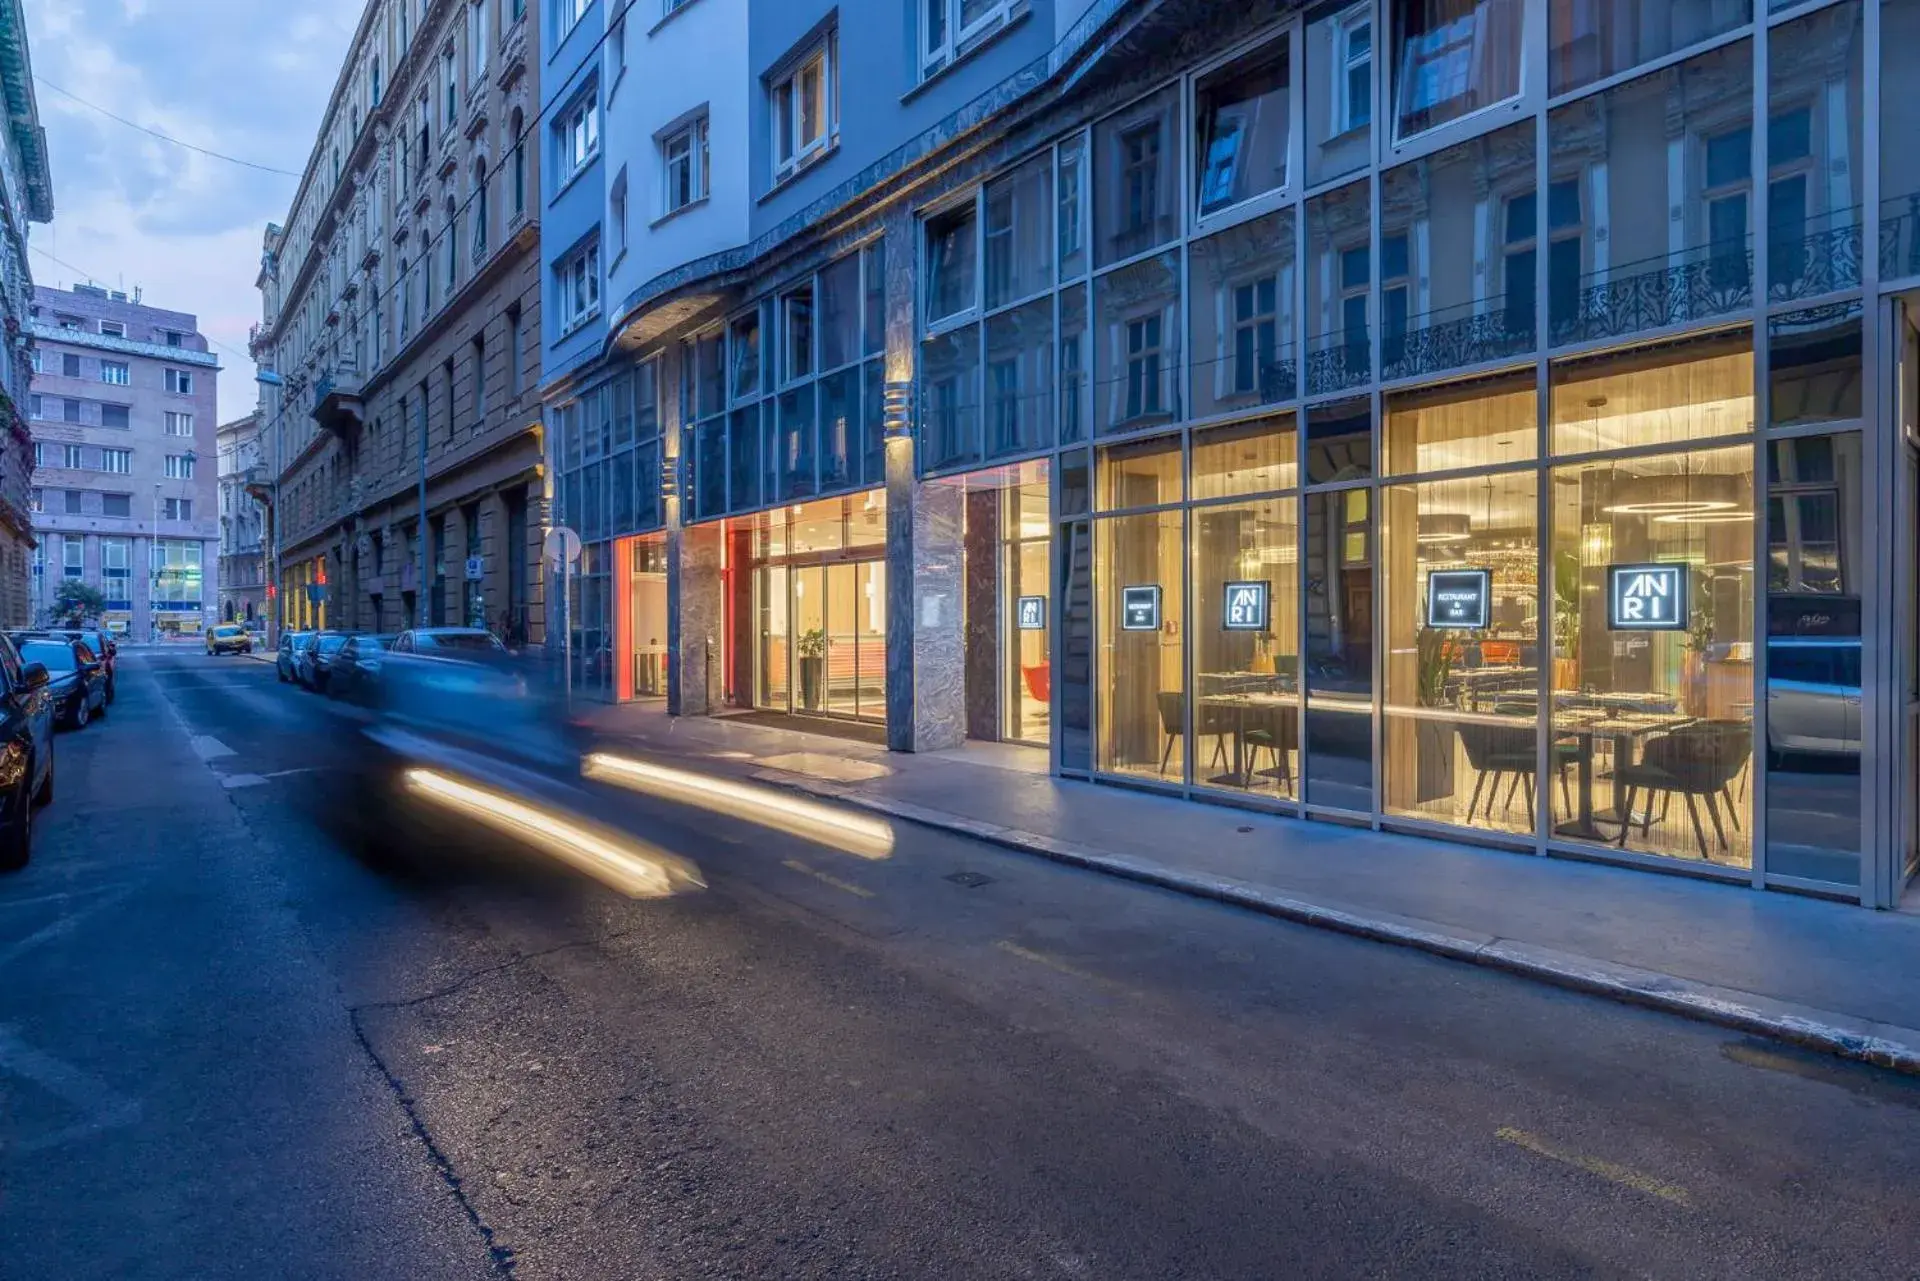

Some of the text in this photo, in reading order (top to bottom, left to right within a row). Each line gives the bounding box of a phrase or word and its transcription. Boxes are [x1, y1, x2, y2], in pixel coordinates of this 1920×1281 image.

[1624, 573, 1667, 596] AN
[1232, 589, 1256, 606] AN
[1231, 606, 1253, 623] RI
[1623, 597, 1660, 619] RI
